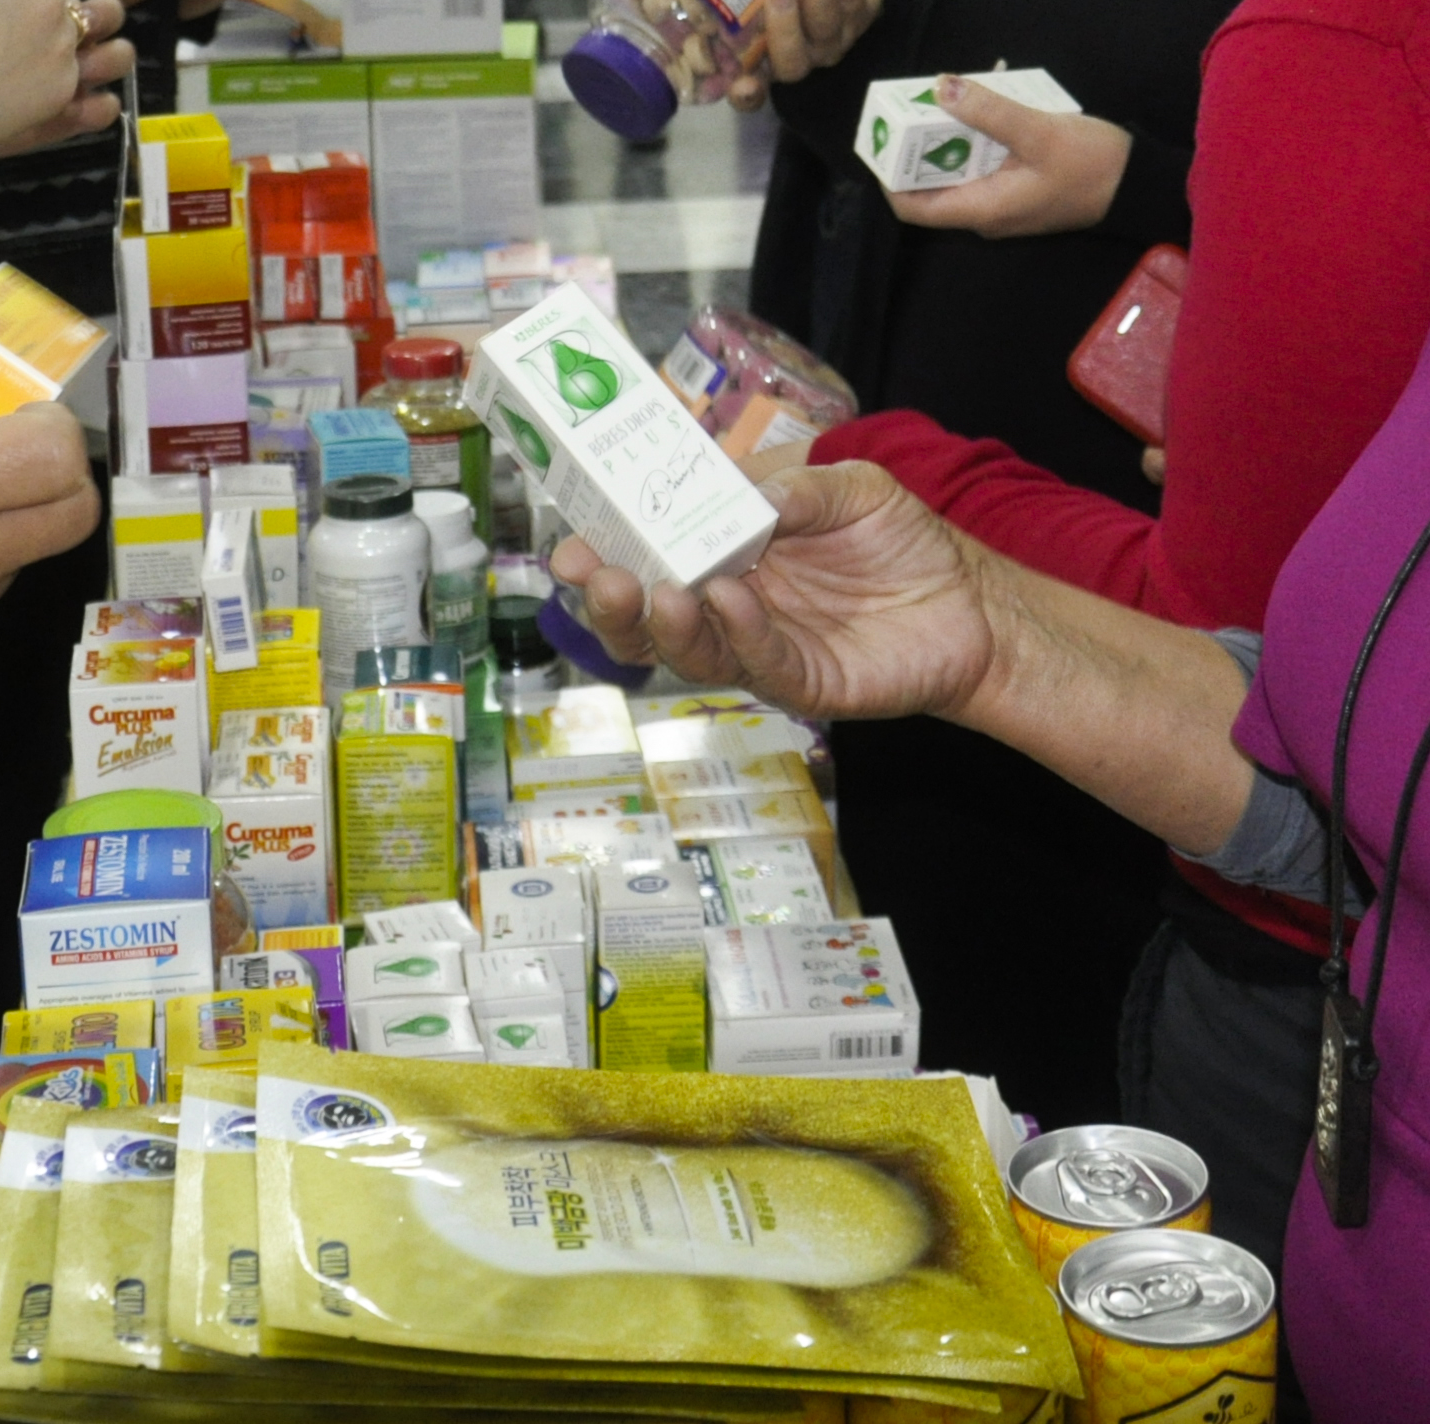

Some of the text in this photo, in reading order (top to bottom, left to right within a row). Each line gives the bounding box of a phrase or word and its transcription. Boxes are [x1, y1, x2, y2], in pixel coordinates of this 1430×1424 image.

[627, 397, 666, 438] DROPS
[88, 704, 176, 726] Curcuma
[115, 720, 153, 736] PLUS
[97, 732, 174, 770] Emulsion
[225, 822, 314, 843] Curcuma
[253, 839, 291, 854] PLUS
[94, 834, 129, 897] ZESTOMIN
[49, 920, 178, 953] ZESTOMIN
[54, 954, 79, 965] AMINO
[81, 952, 104, 963] ACIDS
[113, 948, 148, 960] VITAMINS
[149, 945, 176, 957] SYRUP
